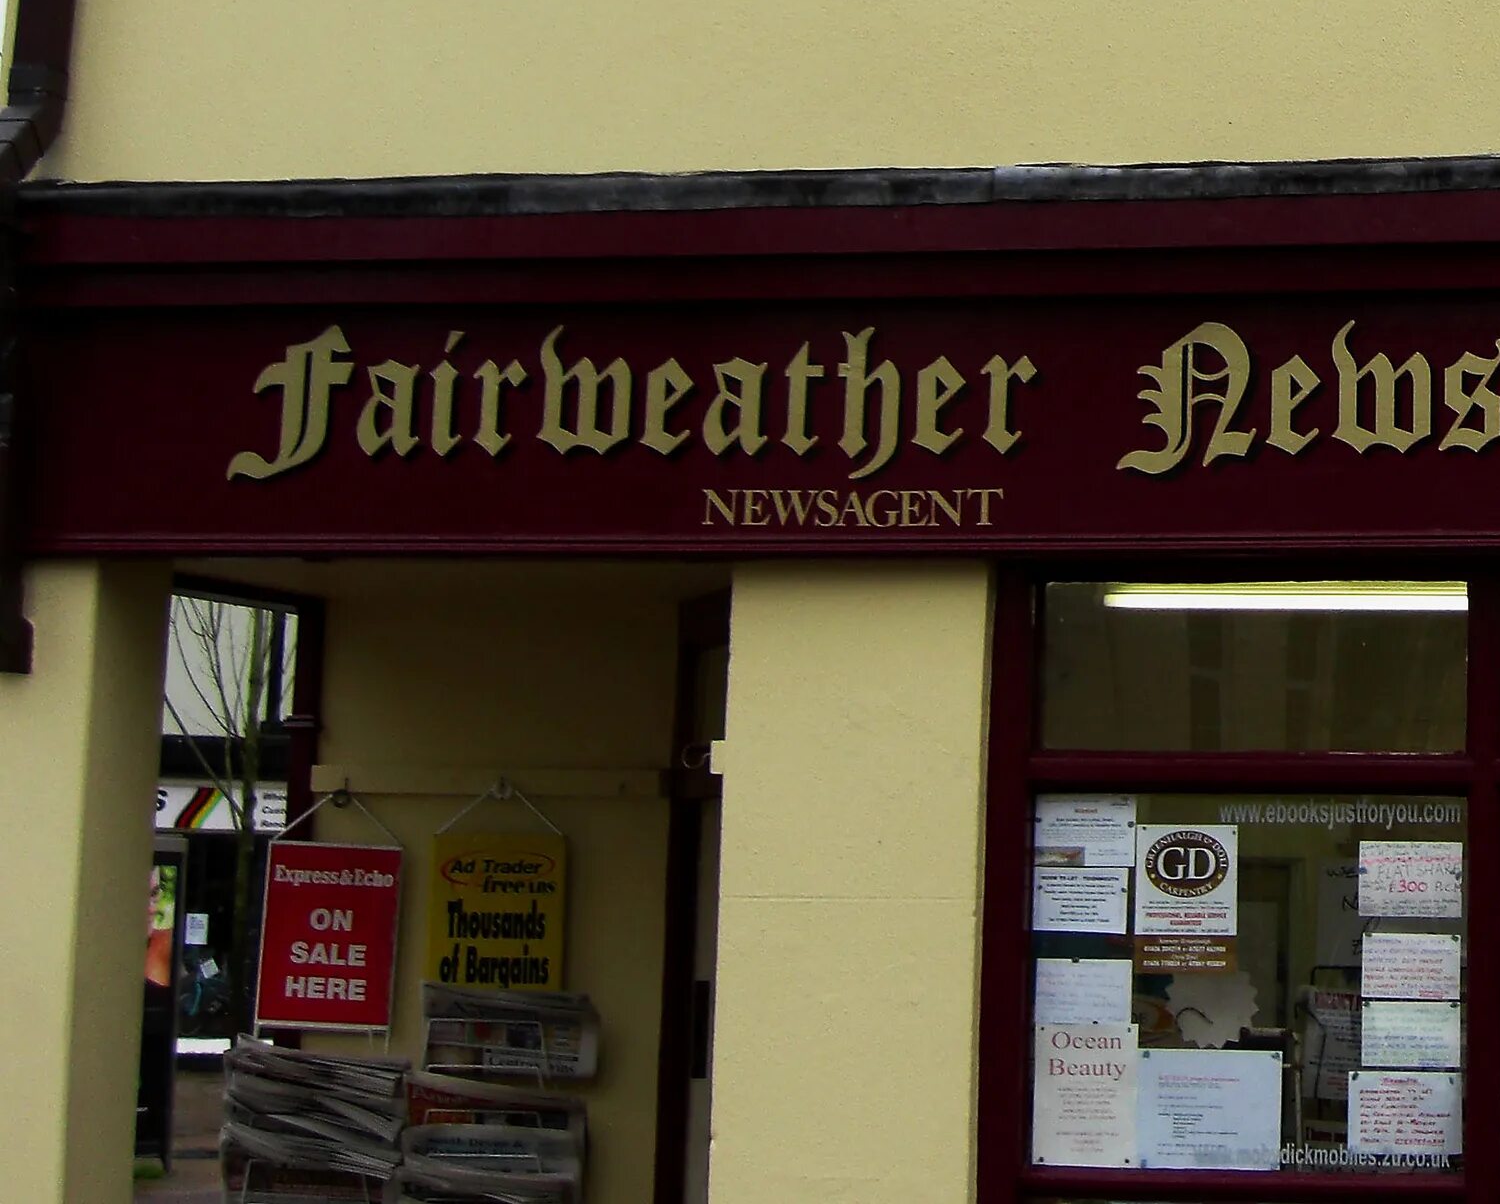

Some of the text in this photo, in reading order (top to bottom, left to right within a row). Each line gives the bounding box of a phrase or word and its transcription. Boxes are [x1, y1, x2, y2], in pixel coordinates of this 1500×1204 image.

[226, 325, 1038, 481] Fairweather
[701, 488, 1004, 527] NEWSAGENT
[1219, 799, 1461, 830] www.ebooksjustforyou.com
[451, 860, 542, 874] Ad Trader
[1157, 847, 1217, 880] GD
[1389, 879, 1428, 893] £300
[310, 908, 353, 931] ON
[448, 899, 545, 939] Thousands
[290, 941, 367, 966] SALE
[440, 943, 549, 988] of Bargains
[285, 976, 367, 1001] HERE
[1052, 1031, 1121, 1049] Ocean
[1048, 1058, 1126, 1081] Beauty
